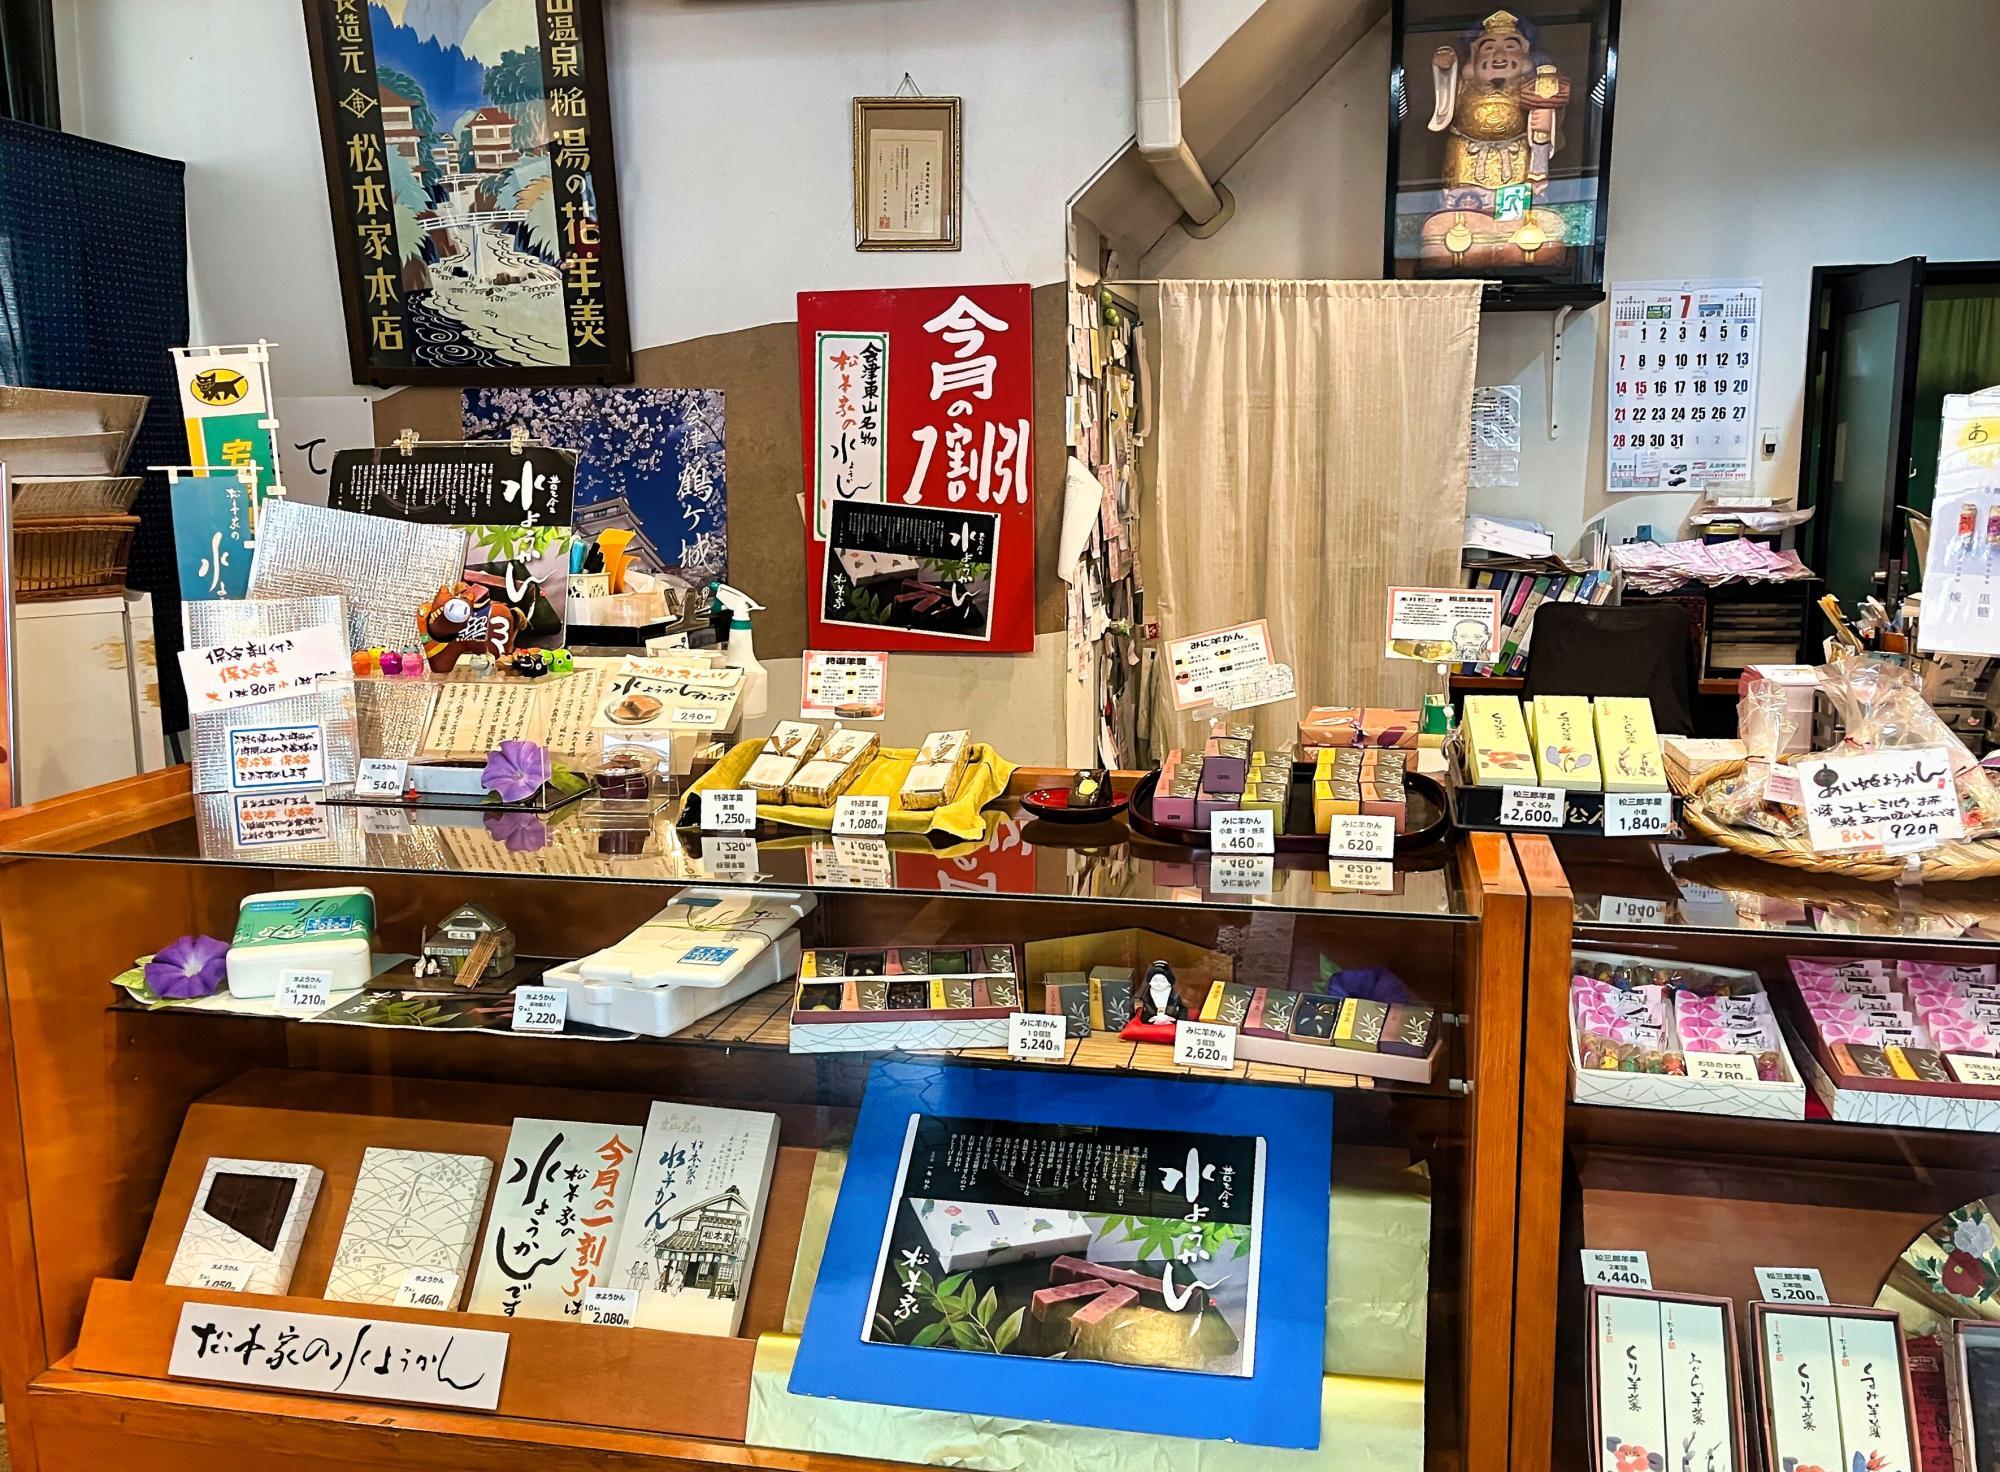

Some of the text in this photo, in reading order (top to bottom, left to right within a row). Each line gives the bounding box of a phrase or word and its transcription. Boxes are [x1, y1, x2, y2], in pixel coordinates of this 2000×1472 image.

[347, 134, 404, 351] 松本家本店
[1680, 295, 1692, 319] 7
[1641, 326, 1748, 340] 1 2 3 4 5 6
[923, 295, 1009, 417] 今月の
[1619, 352, 1749, 368] 7 8 9 10 11 12 13
[858, 341, 883, 447] 会津東山名物
[1616, 380, 1748, 394] 14 15 16 17 18 19 20
[1615, 407, 1746, 420] 21 22 23 24 25 26 27
[1968, 423, 1988, 443] あ
[1613, 435, 1625, 447] 28
[1631, 435, 1645, 447] 29
[1650, 435, 1665, 447] 30
[1670, 434, 1684, 446] 31
[295, 438, 327, 475] て
[1190, 632, 1244, 650] みに羊かん
[205, 640, 294, 664] 保冷剤付き
[219, 658, 280, 683] 保冷袋
[680, 712, 713, 721] 240円
[373, 781, 400, 790] 540円
[715, 813, 751, 825] 1,250円
[1221, 817, 1261, 825] みに羊かん
[1511, 809, 1559, 823] 2,600円
[849, 819, 883, 829] 1,080円
[1341, 821, 1382, 829] みに羊かん
[1619, 817, 1667, 831] 1,840円
[1890, 823, 1938, 839] 920円
[1229, 837, 1263, 849] 460円
[1347, 840, 1382, 852] 620円
[293, 994, 326, 1006] 1,210円
[526, 1013, 562, 1025] 2,220円
[1020, 1020, 1058, 1028] みに羊かん
[1186, 1026, 1226, 1038] みに羊かん
[1020, 1038, 1060, 1052] 5,240円
[1185, 1047, 1228, 1062] 2,620円
[1701, 1070, 1753, 1080] 2,780
[685, 1139, 704, 1186] 松本家の
[644, 1140, 686, 1230] 水羊かん
[555, 1164, 590, 1237] 松本家の
[702, 1229, 733, 1245] 松本家
[1158, 1148, 1233, 1312] 水ようかん
[1595, 1254, 1639, 1263] 松三郎羊羹
[211, 1264, 239, 1272] 水ようかん
[414, 1275, 445, 1284] 水ようかん
[1597, 1272, 1647, 1285] 4,440円
[1767, 1273, 1811, 1281] 松三郎羊羹
[410, 1292, 444, 1306] 1,460円
[595, 1293, 626, 1302] 水ようかん
[1771, 1288, 1823, 1301] 5,200円
[593, 1313, 629, 1326] 2,080円
[1626, 1345, 1642, 1412] くり羊羹
[1798, 1363, 1816, 1432] くり羊羹
[1861, 1363, 1881, 1439] くるみ羊羹
